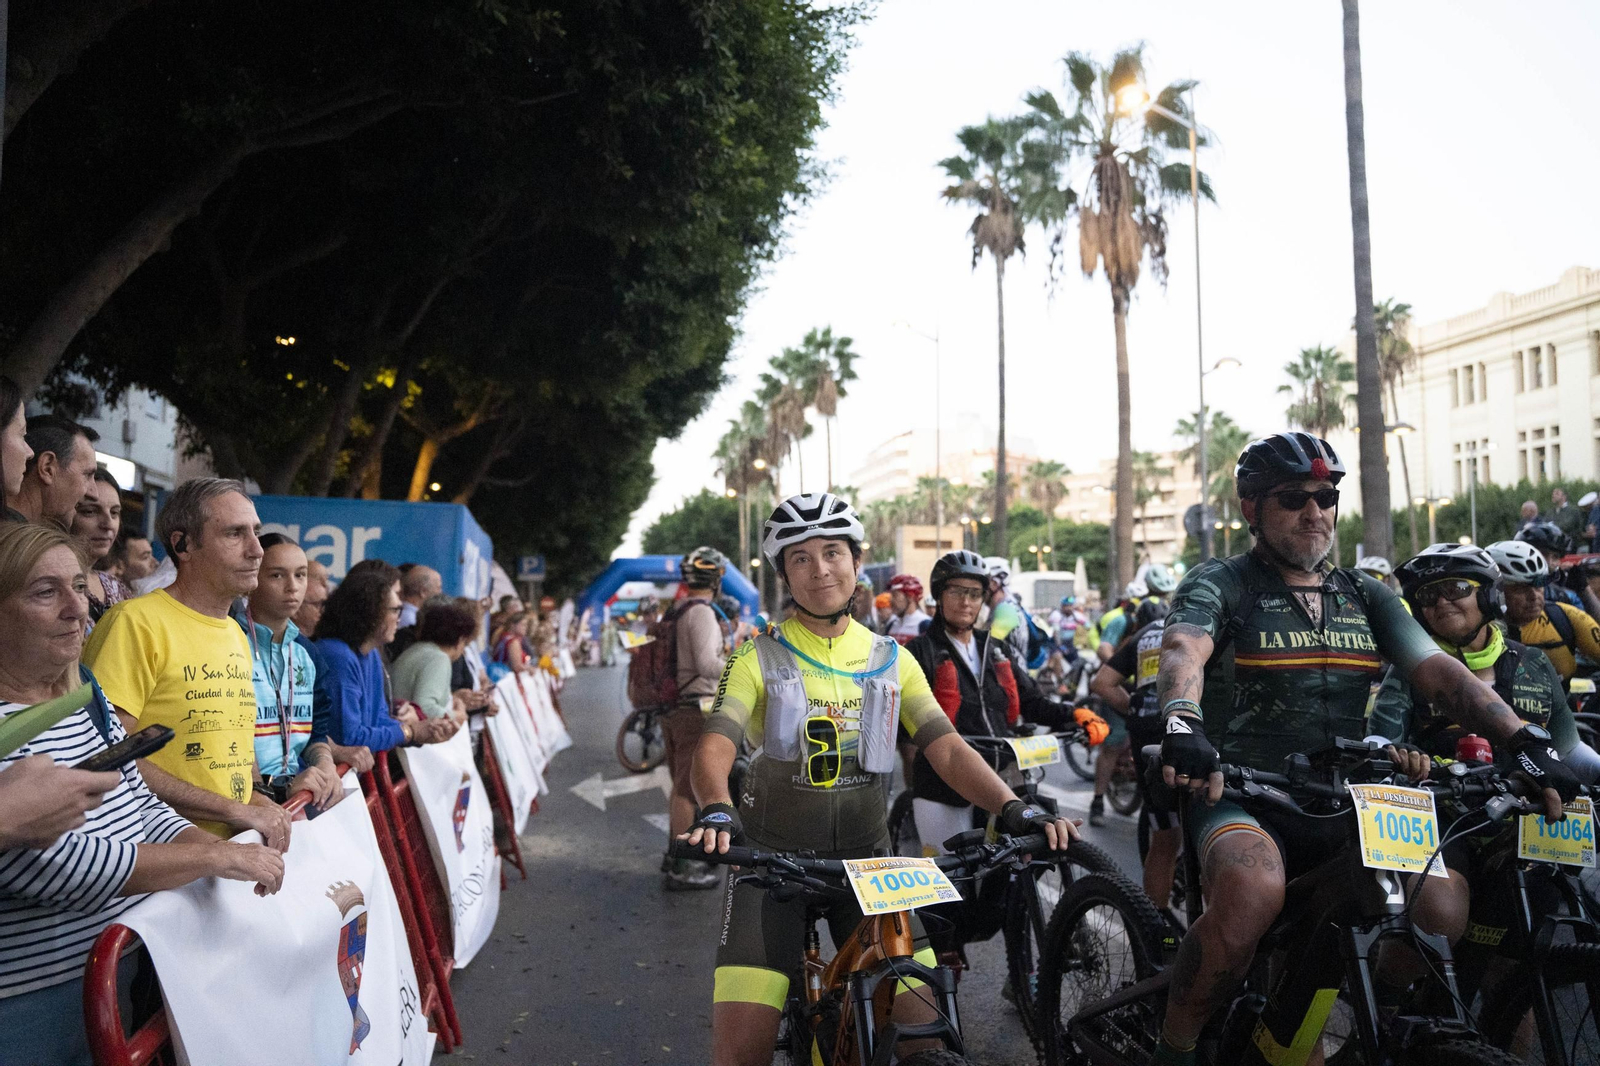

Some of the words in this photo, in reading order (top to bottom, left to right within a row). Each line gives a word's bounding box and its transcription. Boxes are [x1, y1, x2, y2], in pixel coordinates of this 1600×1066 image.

[522, 557, 539, 574] P
[1418, 565, 1445, 578] FOX
[1259, 631, 1286, 649] LA
[183, 664, 196, 681] IV
[201, 663, 224, 680] San
[712, 655, 738, 714] ruraltech
[185, 688, 222, 700] Ciudad
[226, 688, 234, 698] de
[1370, 790, 1381, 800] LA
[1374, 810, 1435, 848] 10051
[1536, 815, 1593, 843] 10064
[1386, 853, 1424, 866] cajamar
[1542, 848, 1579, 858] cajamar
[864, 862, 877, 870] LA
[869, 870, 947, 894] 10002
[890, 893, 935, 906] cajamar
[720, 873, 734, 946] RICARDOSANZ
